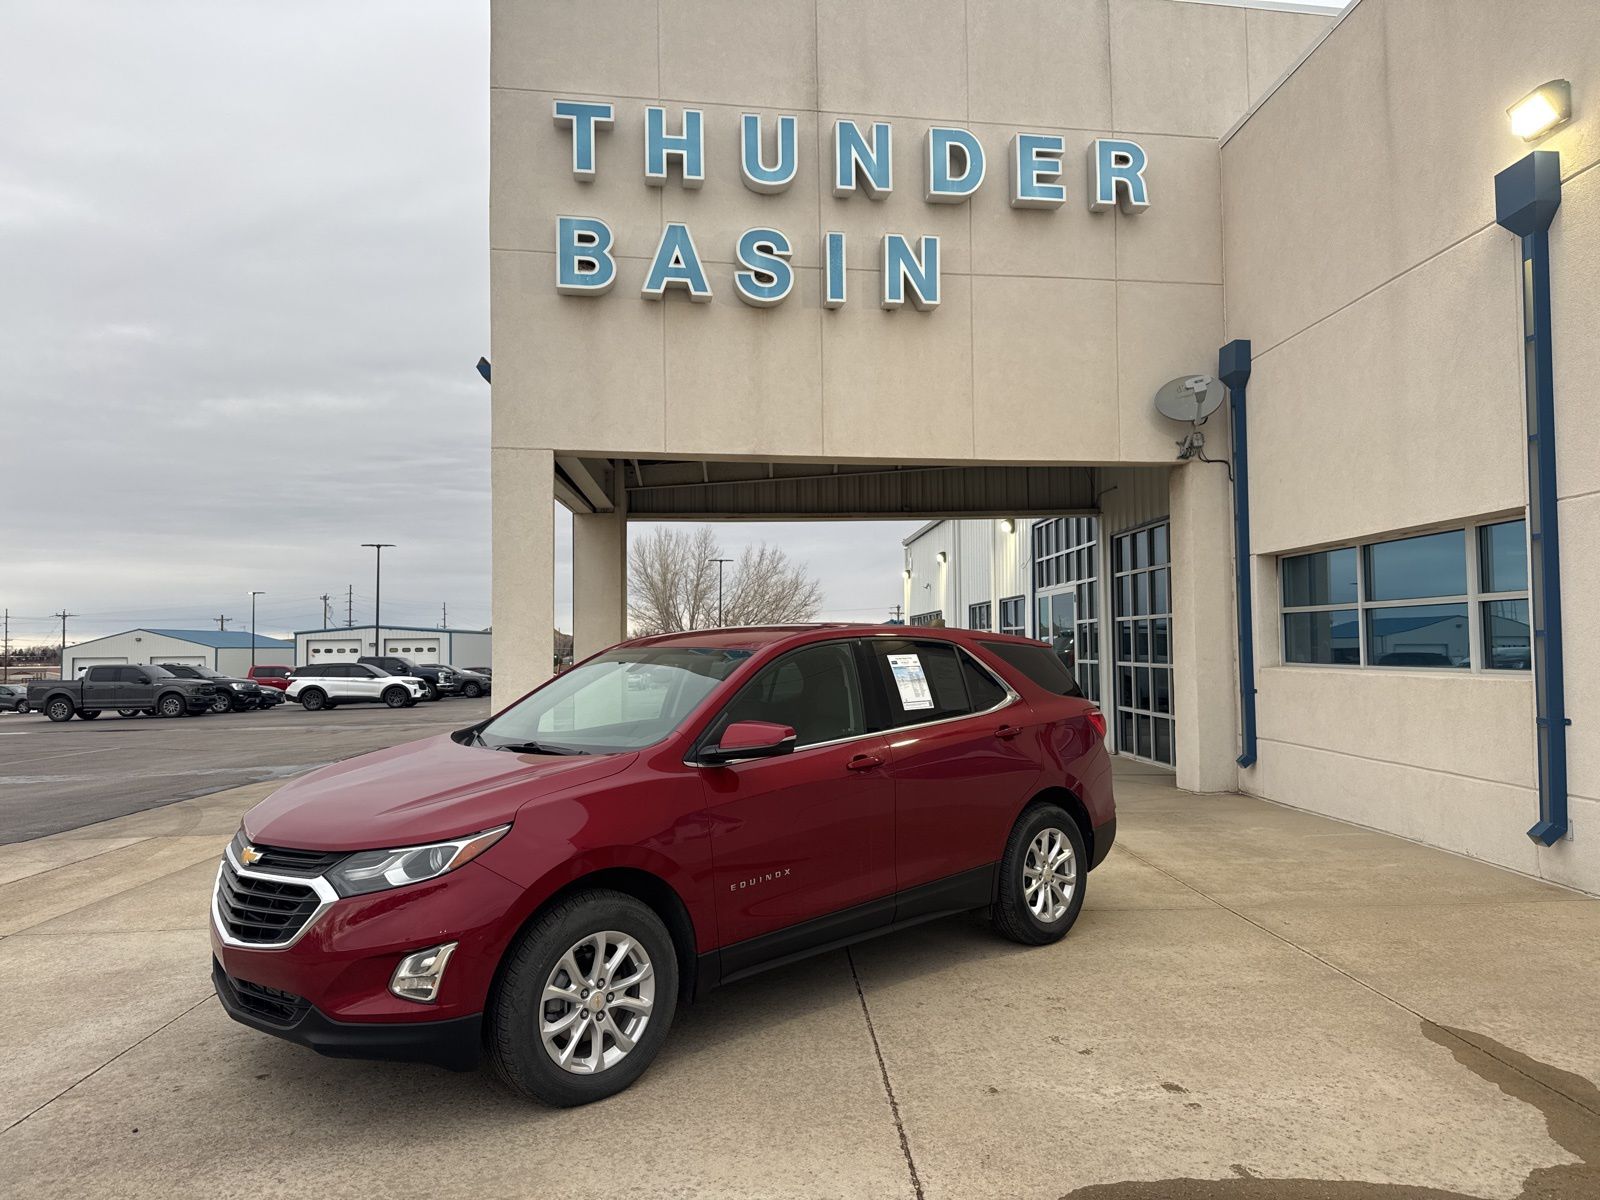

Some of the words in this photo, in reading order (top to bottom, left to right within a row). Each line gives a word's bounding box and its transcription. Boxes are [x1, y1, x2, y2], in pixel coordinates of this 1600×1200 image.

[553, 101, 1150, 208] THUNDER
[555, 215, 941, 306] BASIN
[730, 868, 791, 892] EQUINOX
